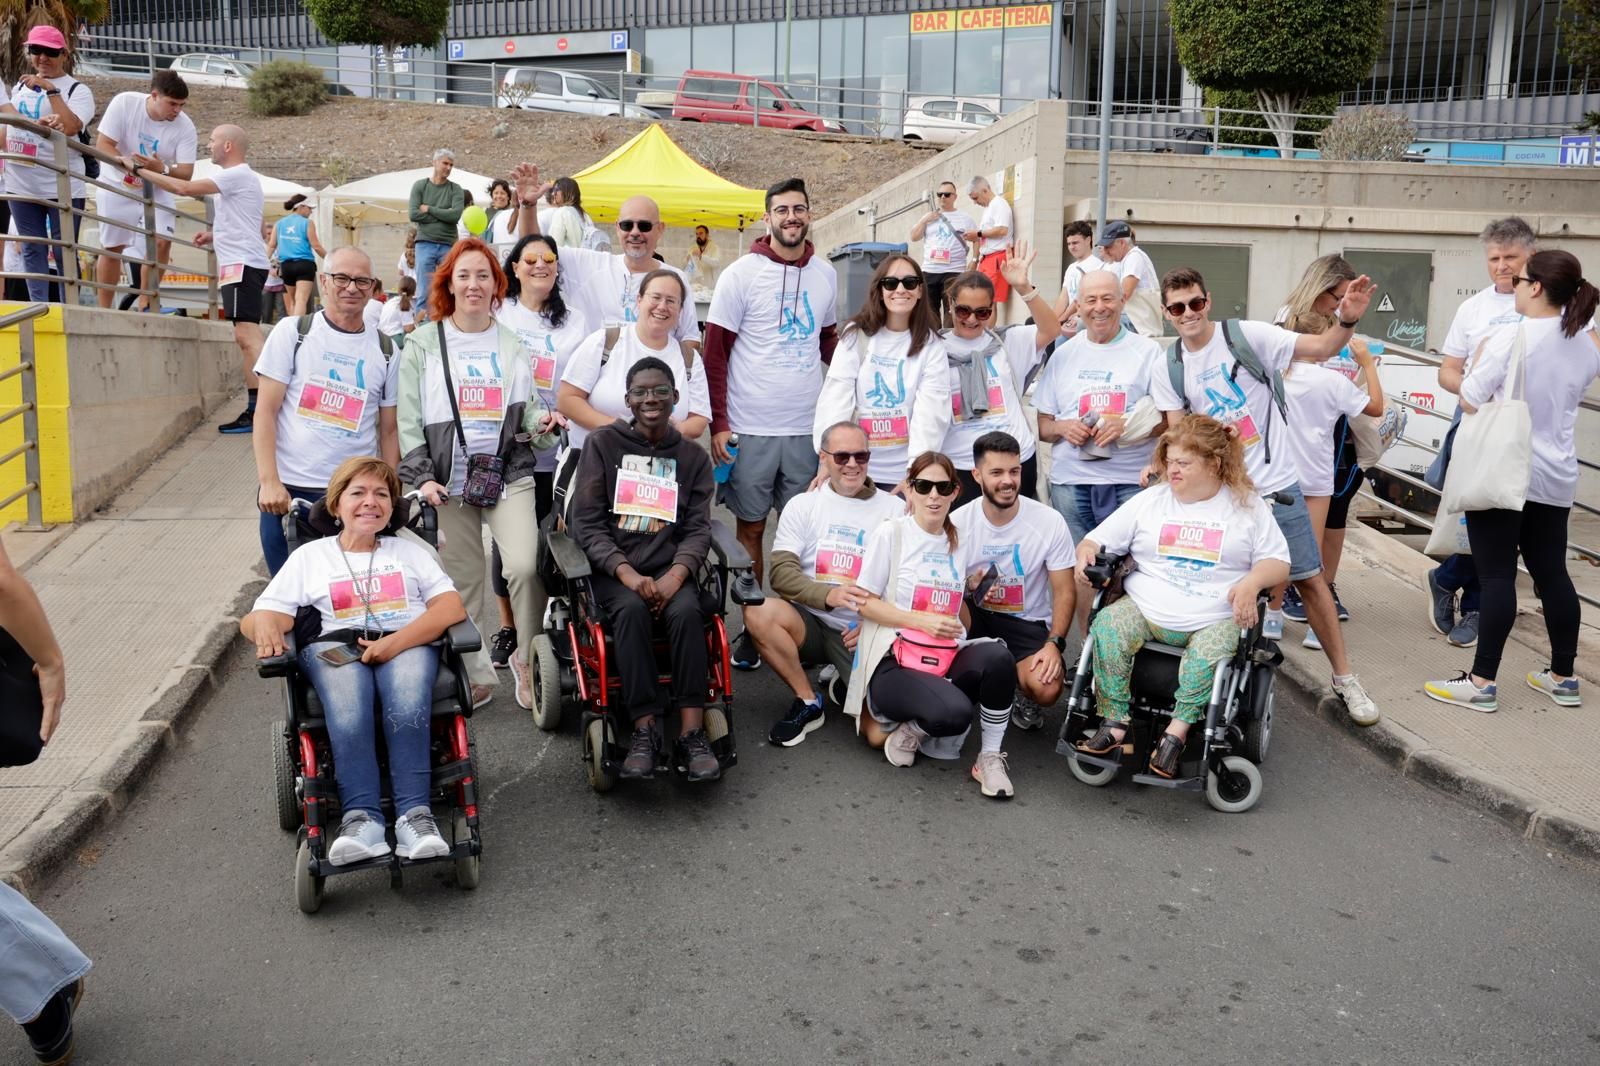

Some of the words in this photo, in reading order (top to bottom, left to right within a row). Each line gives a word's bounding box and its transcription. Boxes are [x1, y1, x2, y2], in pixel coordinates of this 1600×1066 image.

[913, 12, 948, 31] BAR
[960, 5, 1051, 29] CAFETERÍA
[613, 34, 624, 49] P
[451, 43, 461, 58] P
[1515, 152, 1546, 160] COCINA
[320, 390, 345, 409] 000
[462, 388, 485, 402] 000
[1090, 394, 1110, 408] 000
[872, 419, 892, 433] 000
[636, 484, 659, 500] 000
[1180, 526, 1204, 541] 000
[832, 552, 854, 570] 000
[931, 590, 951, 606] 000
